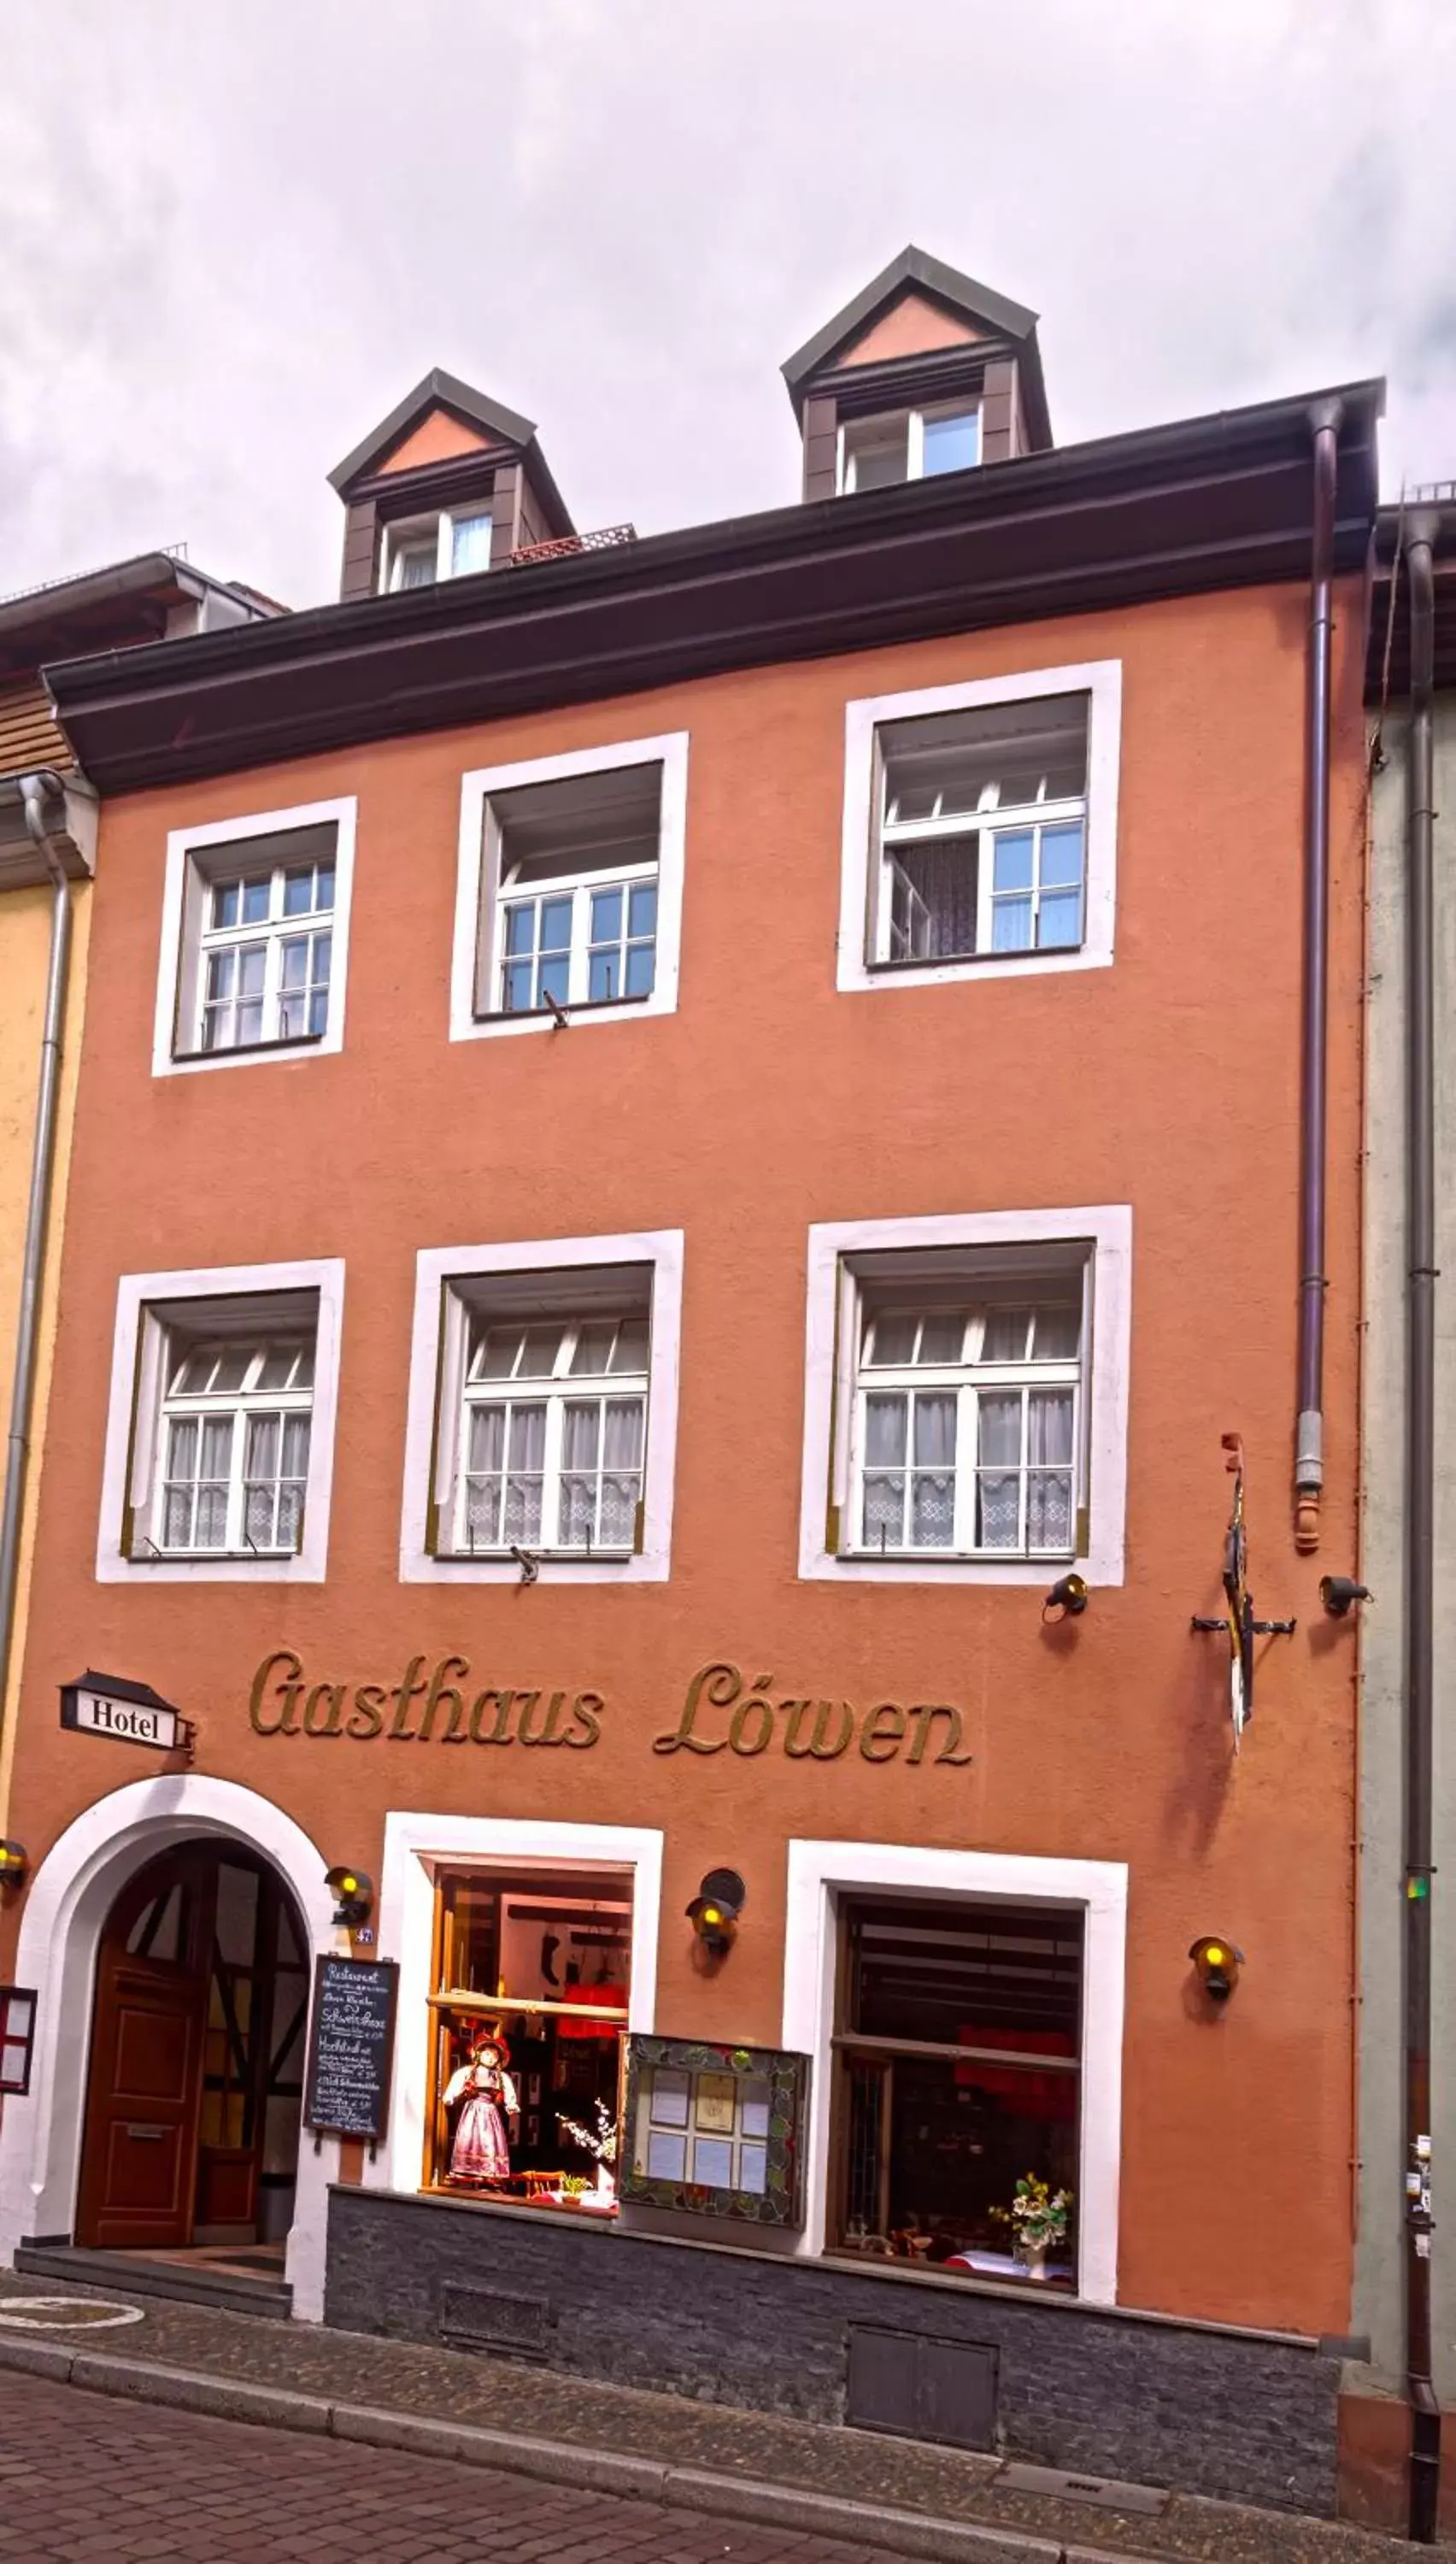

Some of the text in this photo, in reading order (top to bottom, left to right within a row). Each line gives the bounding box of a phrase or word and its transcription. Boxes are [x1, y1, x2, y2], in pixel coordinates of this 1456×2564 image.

[91, 1697, 161, 1741] Hotel
[250, 1650, 973, 1767] Gasthaus Löwen
